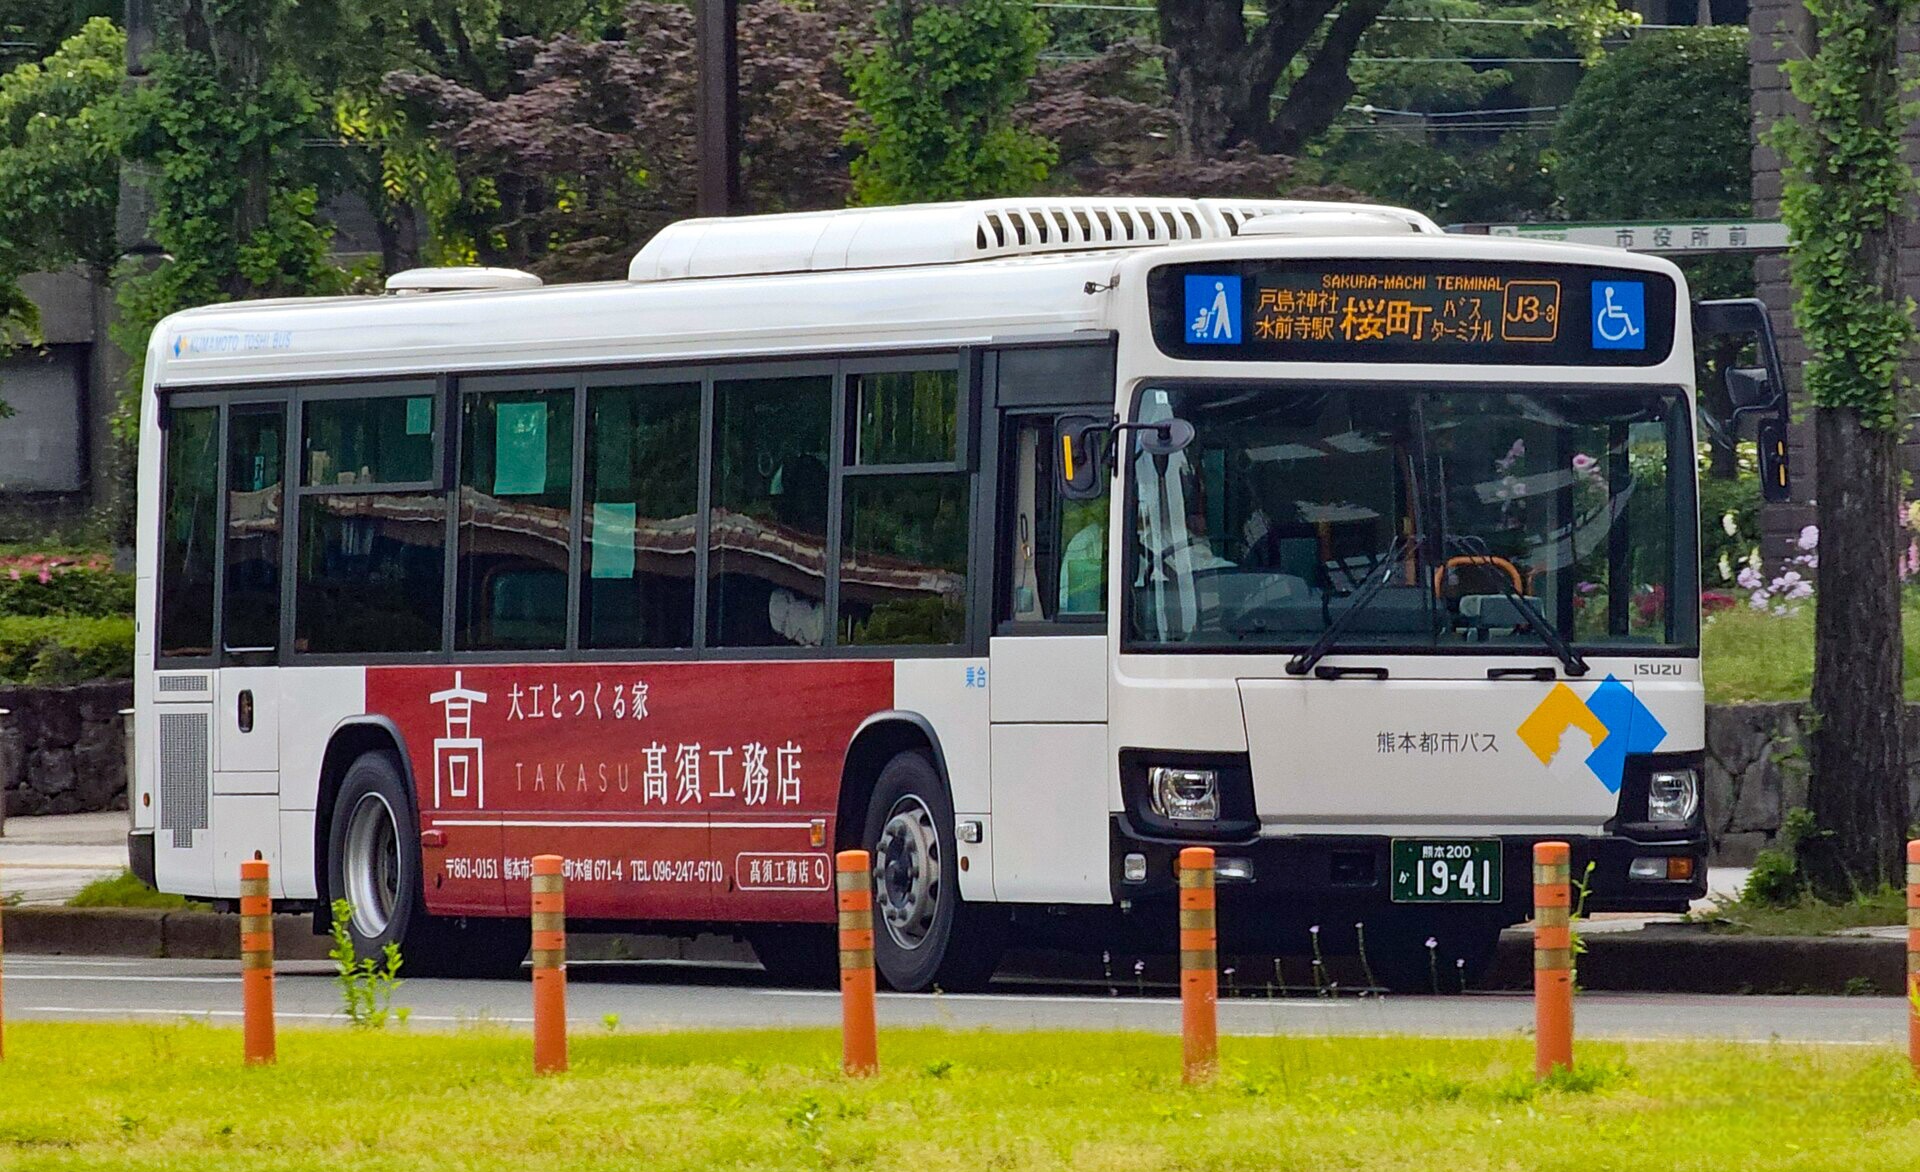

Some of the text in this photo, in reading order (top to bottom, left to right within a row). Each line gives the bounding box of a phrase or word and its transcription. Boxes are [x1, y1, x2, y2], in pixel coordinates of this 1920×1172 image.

[1615, 227, 1747, 248] 市役所前
[1322, 274, 1505, 291] SAKURA-MACHI TERMINAL
[1257, 288, 1339, 314] 戸島神社
[1443, 297, 1482, 320] バス
[1254, 314, 1335, 341] 水前寺駅
[1339, 296, 1433, 341] 桜町
[1431, 318, 1494, 342] ターミナル
[244, 333, 270, 350] TOSHI
[272, 331, 292, 349] BUS
[1634, 664, 1682, 675] ISUZU
[507, 680, 649, 721] 大工とつくる家
[1376, 731, 1499, 755] 熊本都市バス
[515, 762, 629, 792] TAKASU
[653, 860, 723, 882] 096-247-6710
[1416, 860, 1490, 895] 19-41
